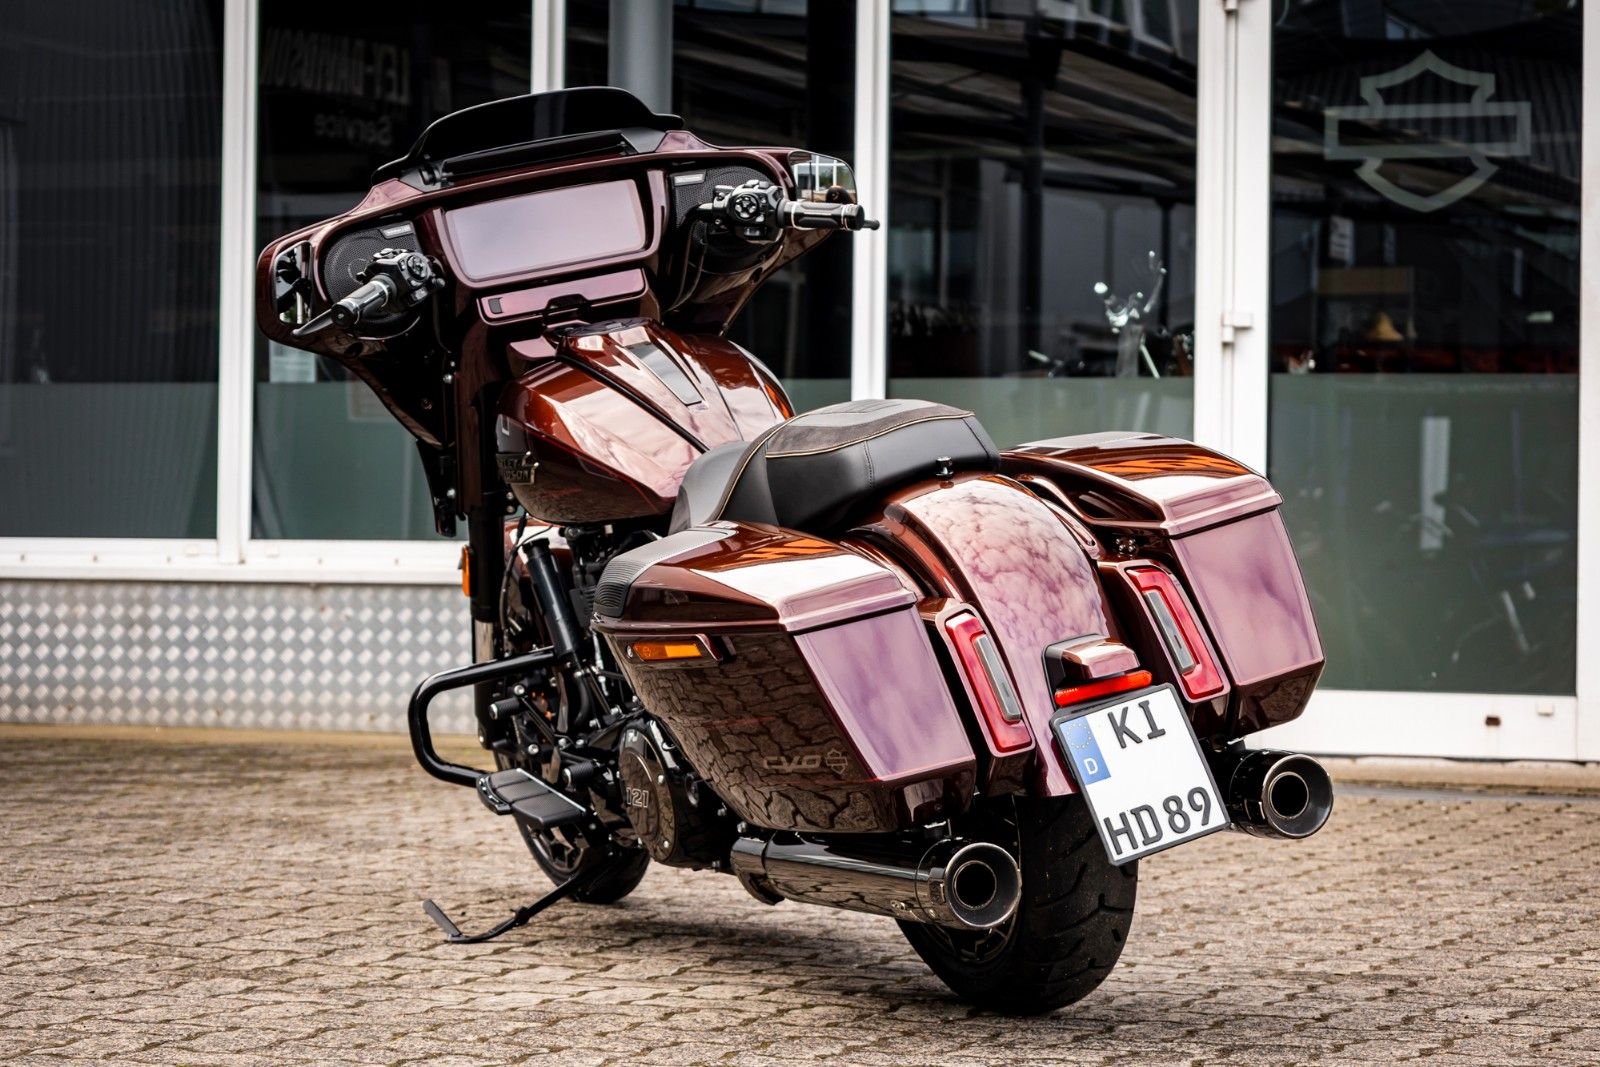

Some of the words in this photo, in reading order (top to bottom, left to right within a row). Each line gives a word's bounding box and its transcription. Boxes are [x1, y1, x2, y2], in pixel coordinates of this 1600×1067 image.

[1107, 700, 1166, 749] KI
[763, 755, 823, 773] CVO
[1083, 757, 1099, 775] D
[625, 787, 650, 808] 121
